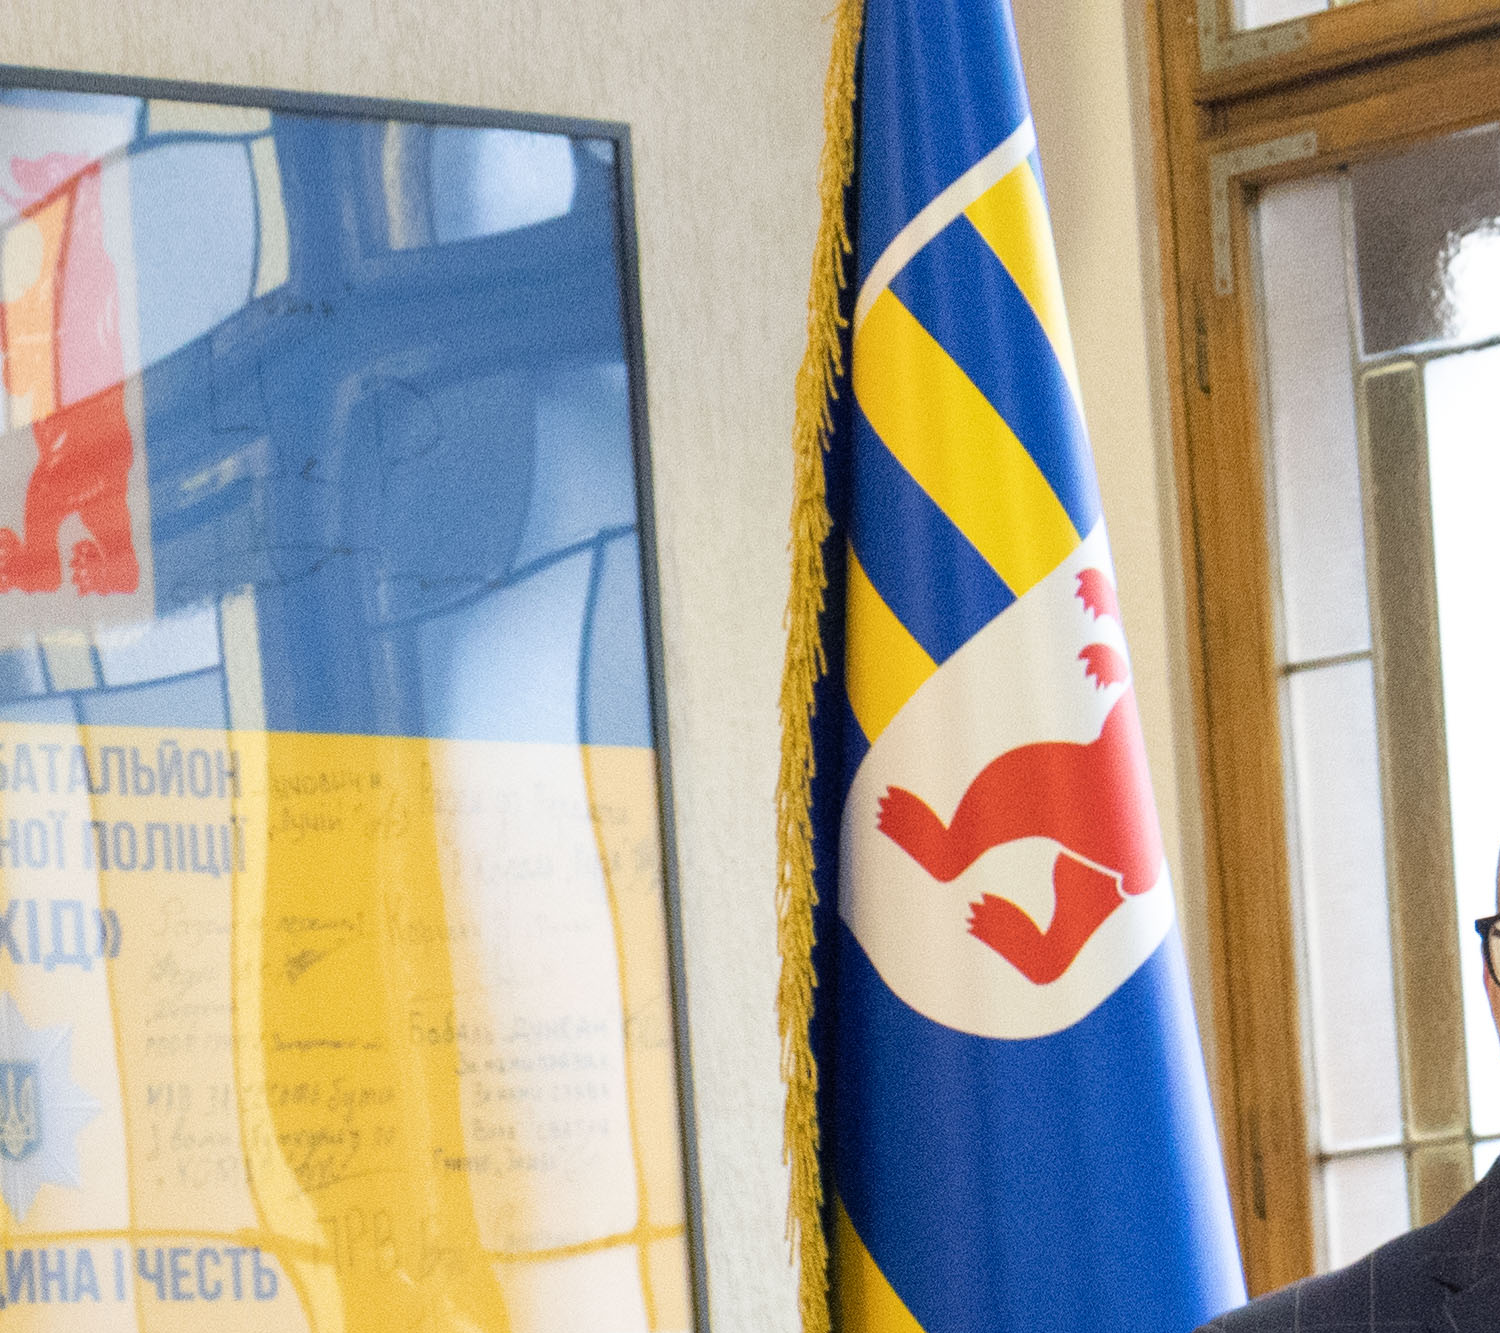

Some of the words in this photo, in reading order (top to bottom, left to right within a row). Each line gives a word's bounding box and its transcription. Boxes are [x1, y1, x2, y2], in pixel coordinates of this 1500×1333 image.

[87, 815, 247, 879] ПОЛІЦІЇ
[113, 1247, 128, 1303] І
[137, 1245, 280, 1303] ЧЕСТЬ
